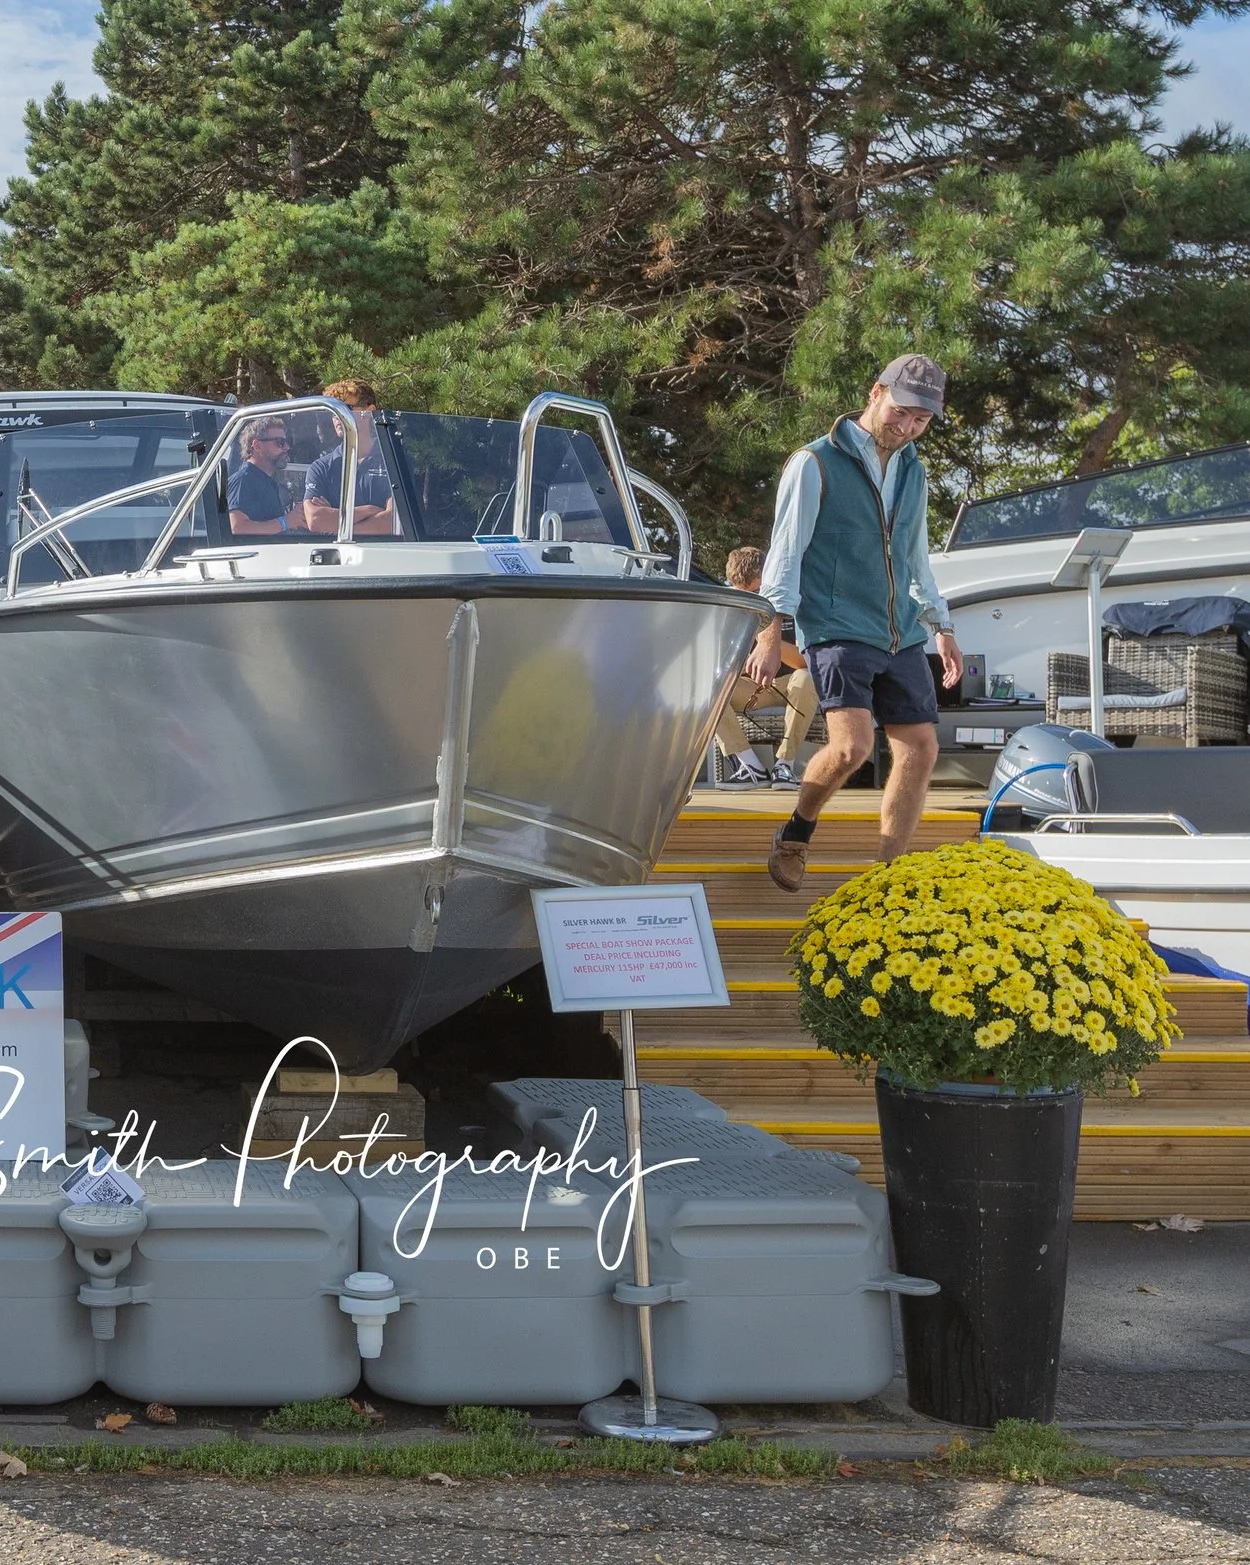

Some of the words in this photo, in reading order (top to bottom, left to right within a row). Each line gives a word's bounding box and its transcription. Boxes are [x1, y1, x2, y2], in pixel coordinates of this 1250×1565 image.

[563, 919, 588, 927] SILVER
[590, 918, 614, 926] HAWK
[616, 917, 627, 925] BR
[636, 915, 688, 926] Silver
[565, 941, 599, 951] SPECIAL
[601, 940, 625, 949] BOAT
[625, 938, 653, 948] SHOW
[655, 937, 694, 946] PACKAGE
[584, 953, 607, 961] DEAL
[608, 951, 632, 960] PRICE
[634, 949, 681, 959] INCLUDING
[573, 964, 616, 974] MERCURY
[618, 963, 645, 972] 115HP
[650, 961, 683, 971] £47,000
[684, 961, 698, 969] inc
[630, 974, 646, 983] VAT
